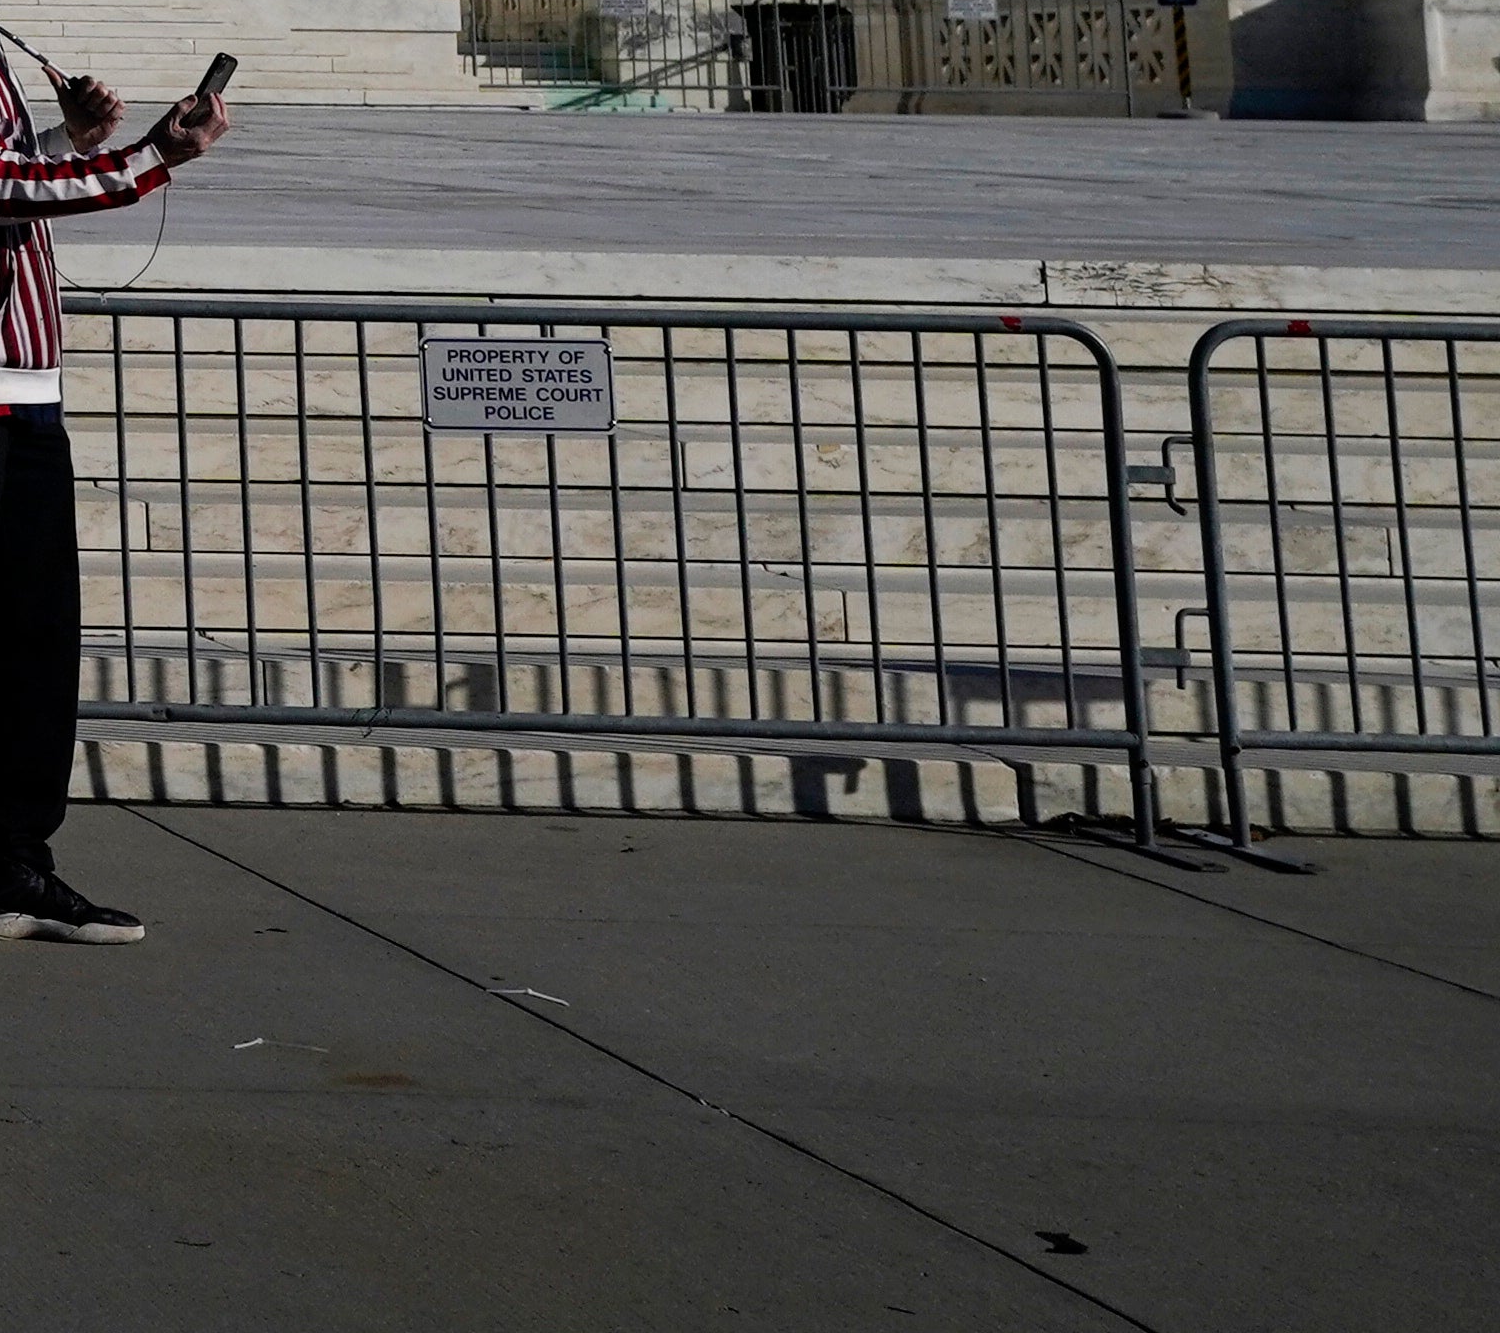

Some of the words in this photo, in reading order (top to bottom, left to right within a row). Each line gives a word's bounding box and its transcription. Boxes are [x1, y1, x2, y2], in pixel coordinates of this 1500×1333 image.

[447, 349, 550, 364] PROPERTY
[558, 351, 585, 364] OF
[442, 368, 512, 382] UNITED
[522, 369, 592, 383] STATES
[433, 386, 527, 401] SUPREME
[536, 388, 604, 402] COURT
[485, 406, 555, 420] POLICE
